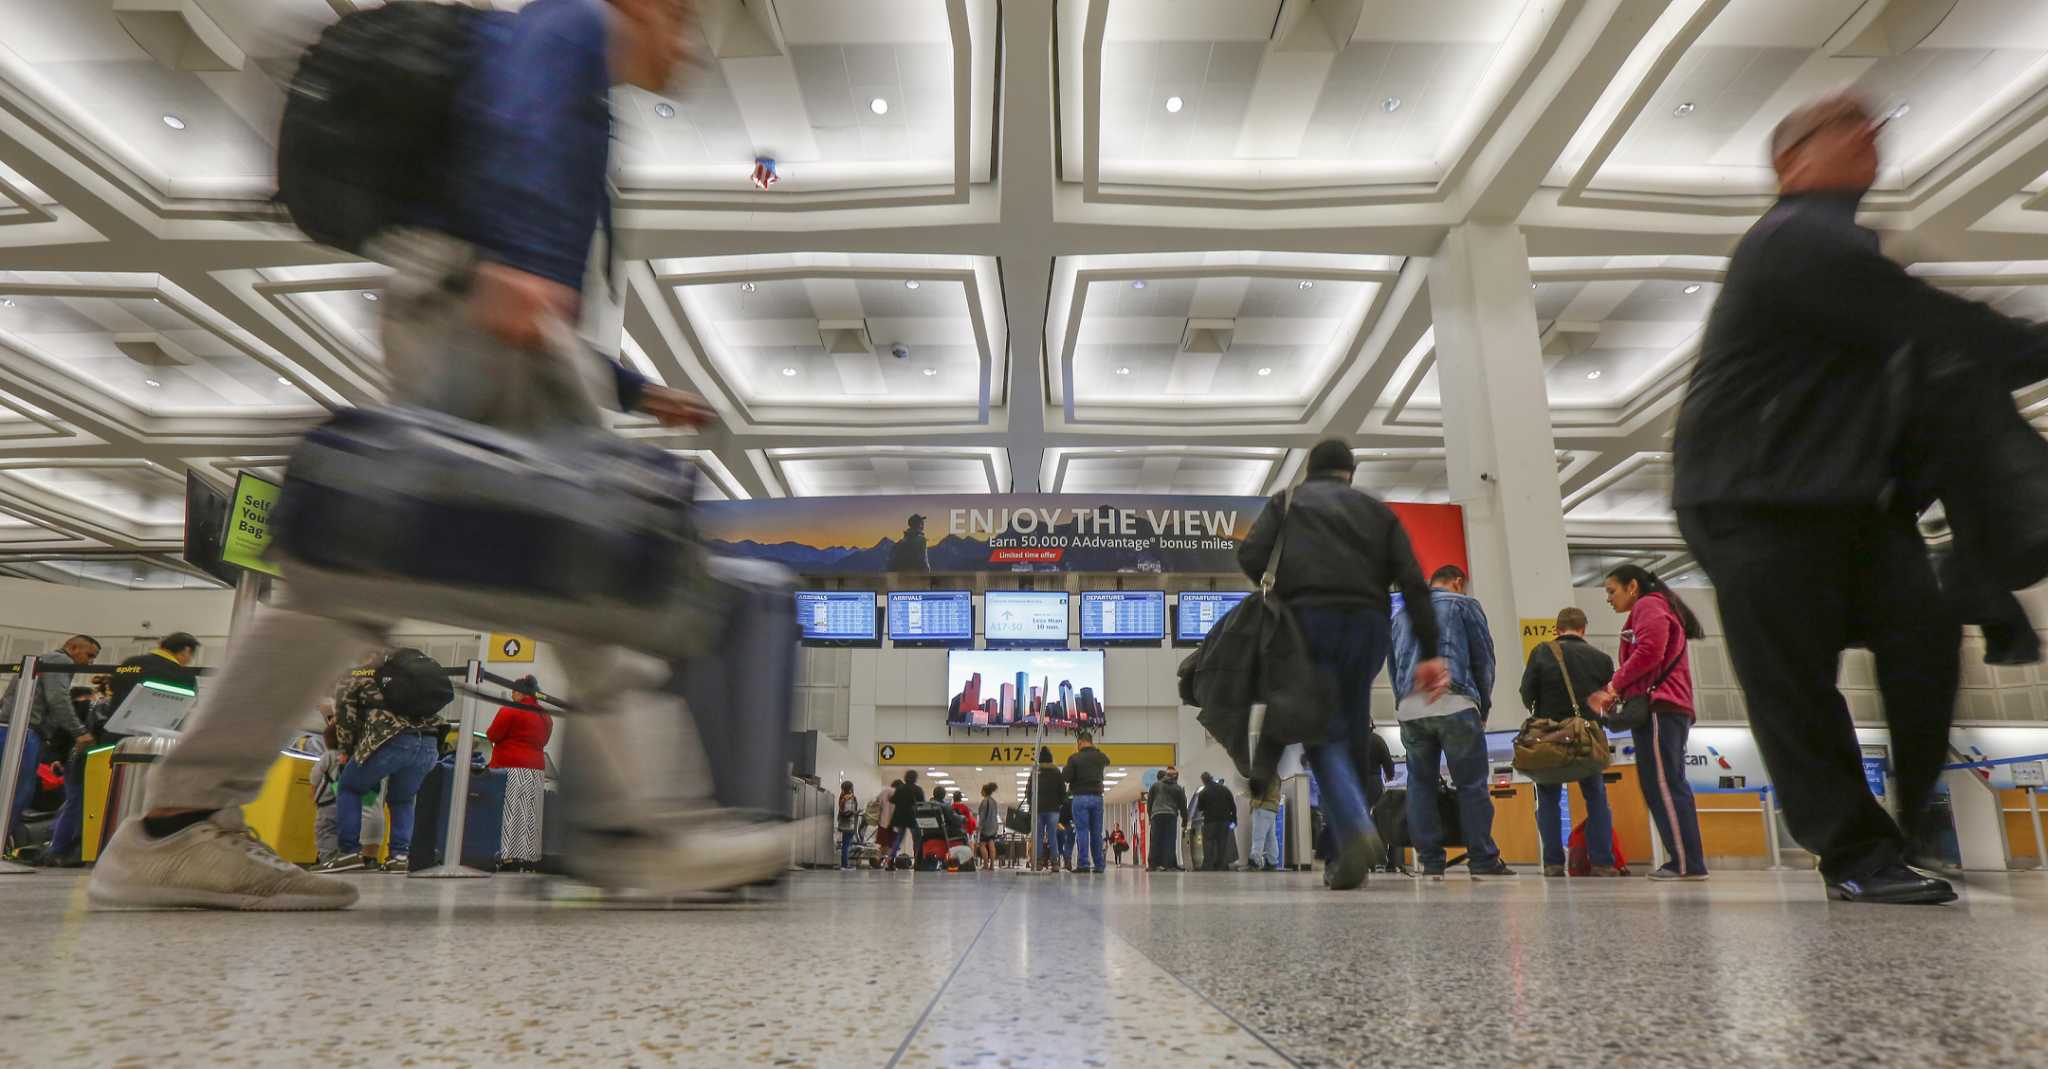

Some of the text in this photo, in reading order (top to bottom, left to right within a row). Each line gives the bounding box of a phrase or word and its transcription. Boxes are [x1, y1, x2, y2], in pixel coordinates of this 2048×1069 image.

[244, 495, 272, 511] Self
[239, 520, 263, 539] Bag
[949, 508, 1238, 536] ENJOY THE VIEW
[989, 535, 1017, 548] Earn
[1021, 536, 1068, 548] 50,000
[1159, 537, 1198, 549] bonus
[1201, 537, 1234, 550] miles
[999, 551, 1056, 559] Limited time offer
[116, 665, 142, 674] spirit
[351, 668, 376, 677] spirit
